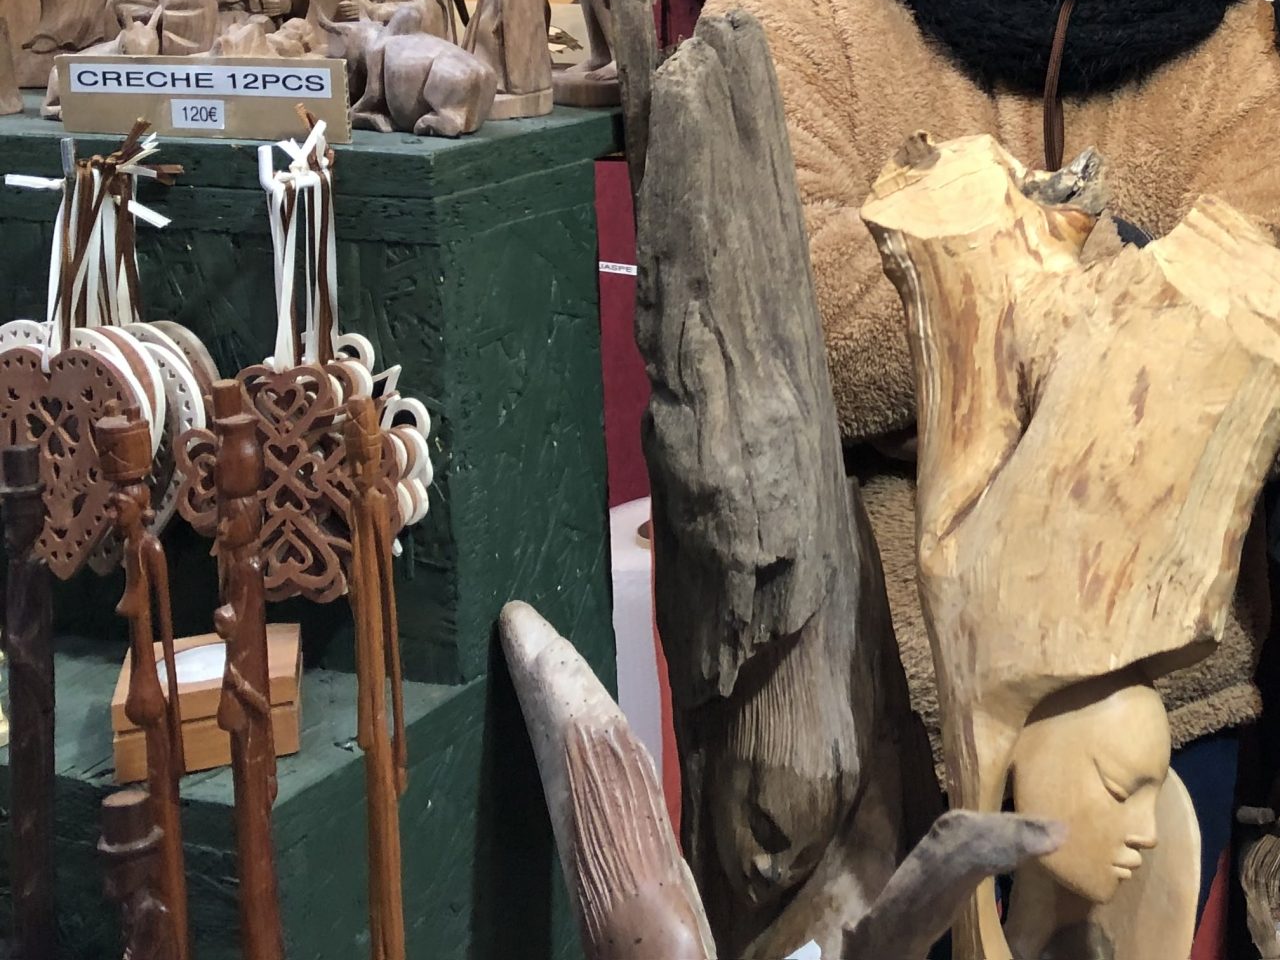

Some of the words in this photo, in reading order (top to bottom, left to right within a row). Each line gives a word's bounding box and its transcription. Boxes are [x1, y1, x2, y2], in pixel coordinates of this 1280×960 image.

[76, 70, 214, 89] CRECHE
[226, 73, 325, 91] 12PCS
[181, 106, 218, 122] 120€
